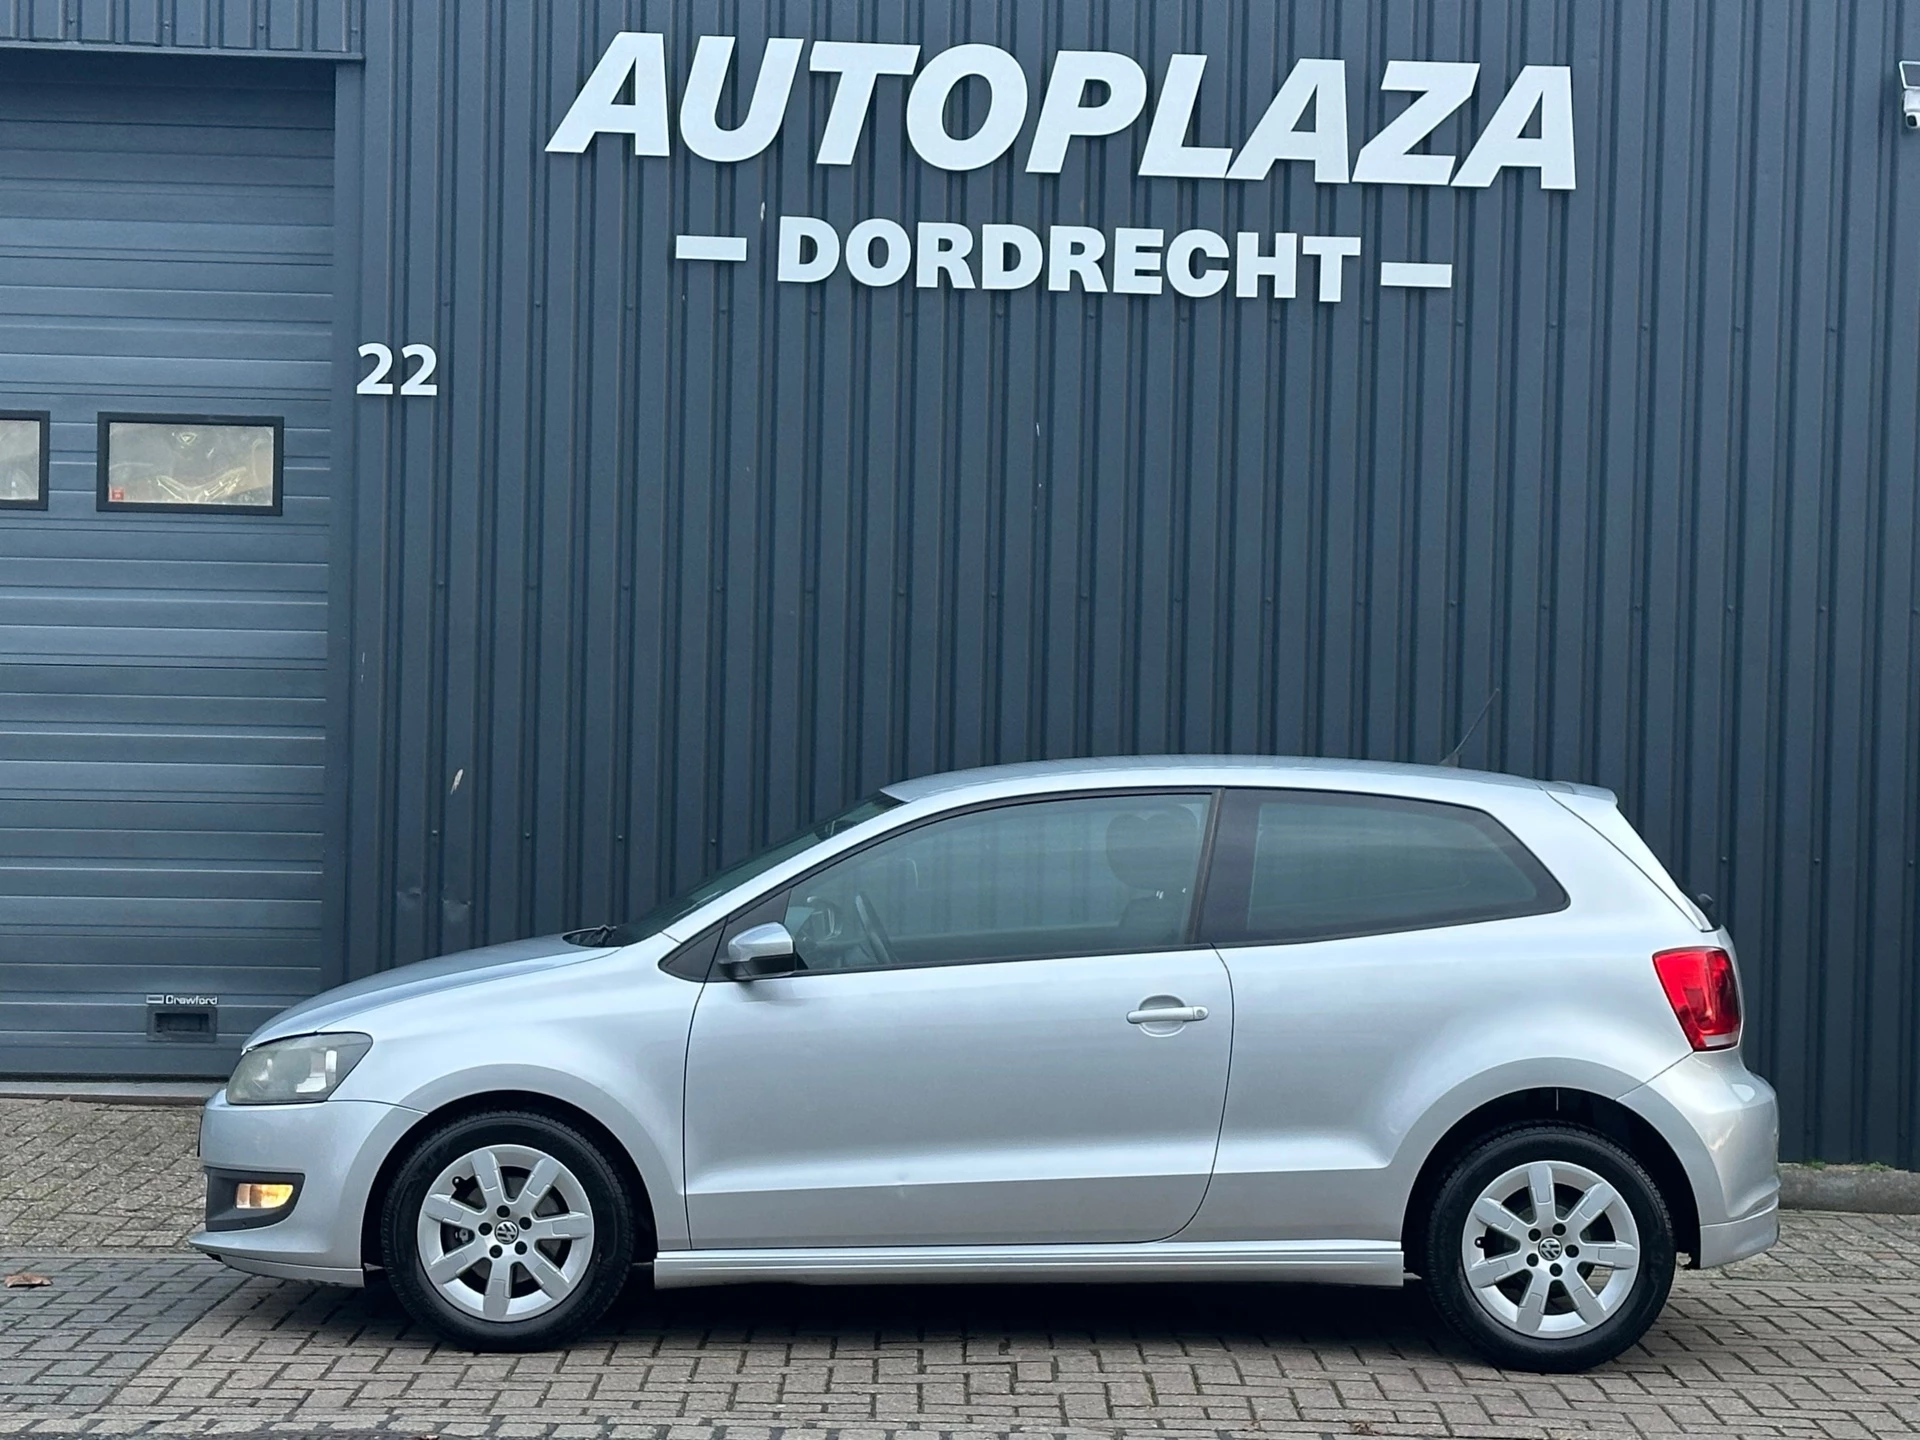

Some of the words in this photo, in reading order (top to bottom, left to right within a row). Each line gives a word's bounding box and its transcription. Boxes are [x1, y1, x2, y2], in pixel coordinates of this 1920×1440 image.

[545, 32, 1576, 190] AUTOPLAZA
[778, 216, 1361, 303] DORDRECHT
[356, 342, 438, 396] 22
[165, 994, 218, 1005] Crawford
